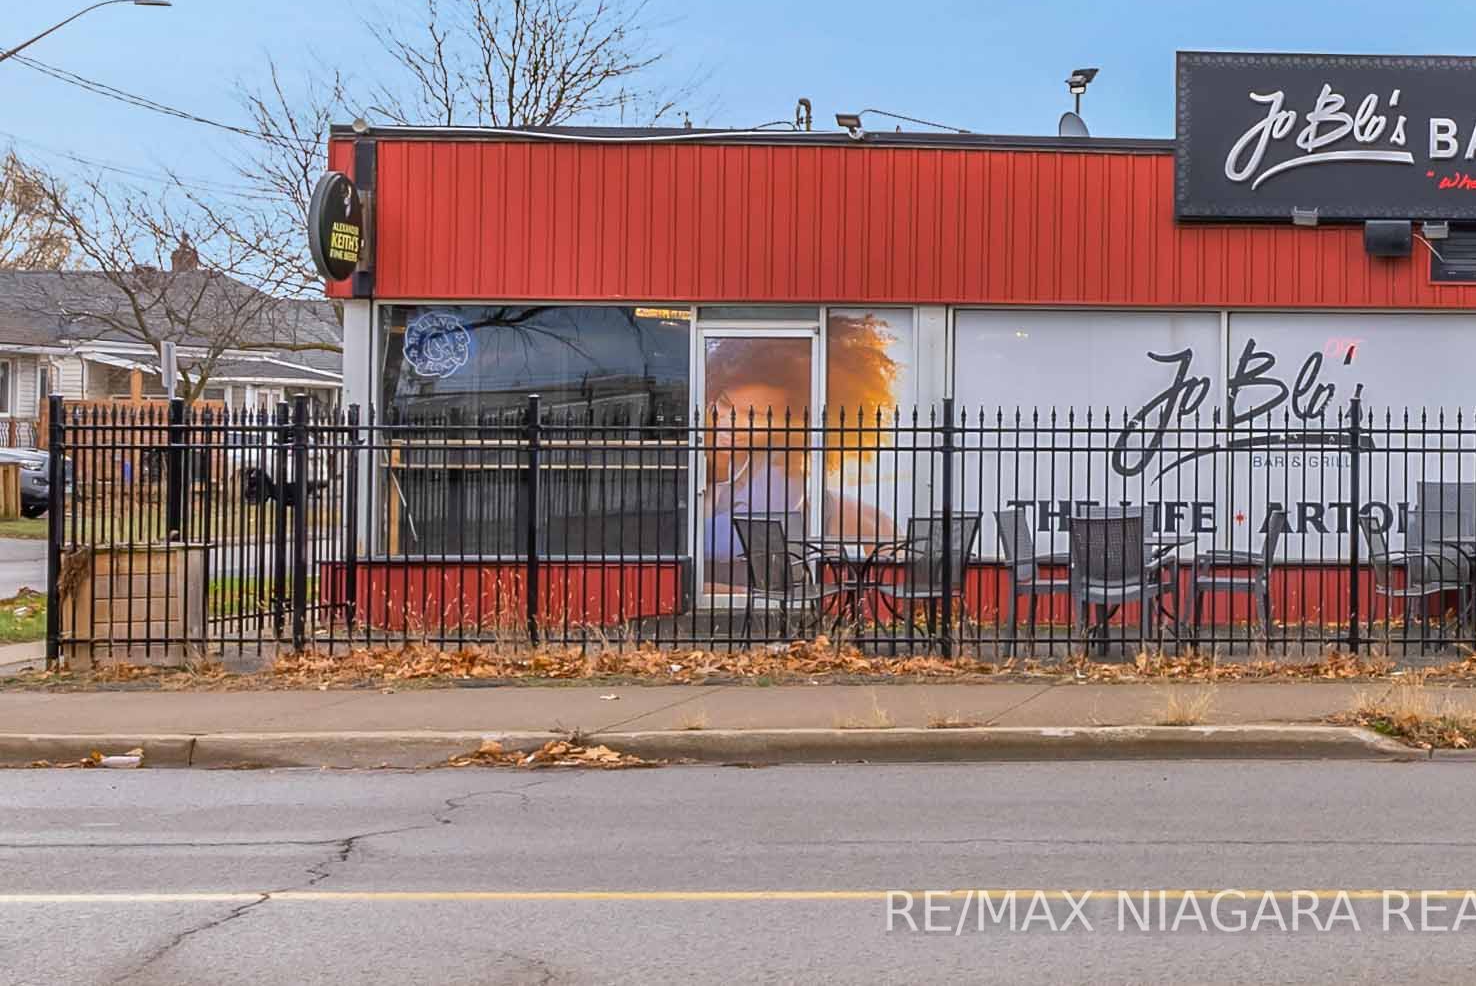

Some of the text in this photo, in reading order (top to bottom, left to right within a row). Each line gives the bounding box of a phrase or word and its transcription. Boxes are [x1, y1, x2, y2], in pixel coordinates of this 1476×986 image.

[1225, 91, 1297, 182] Jo
[1296, 83, 1408, 153] Blo's
[1111, 348, 1211, 477] Jo
[1253, 455, 1285, 468] BAR
[1291, 455, 1301, 468] &
